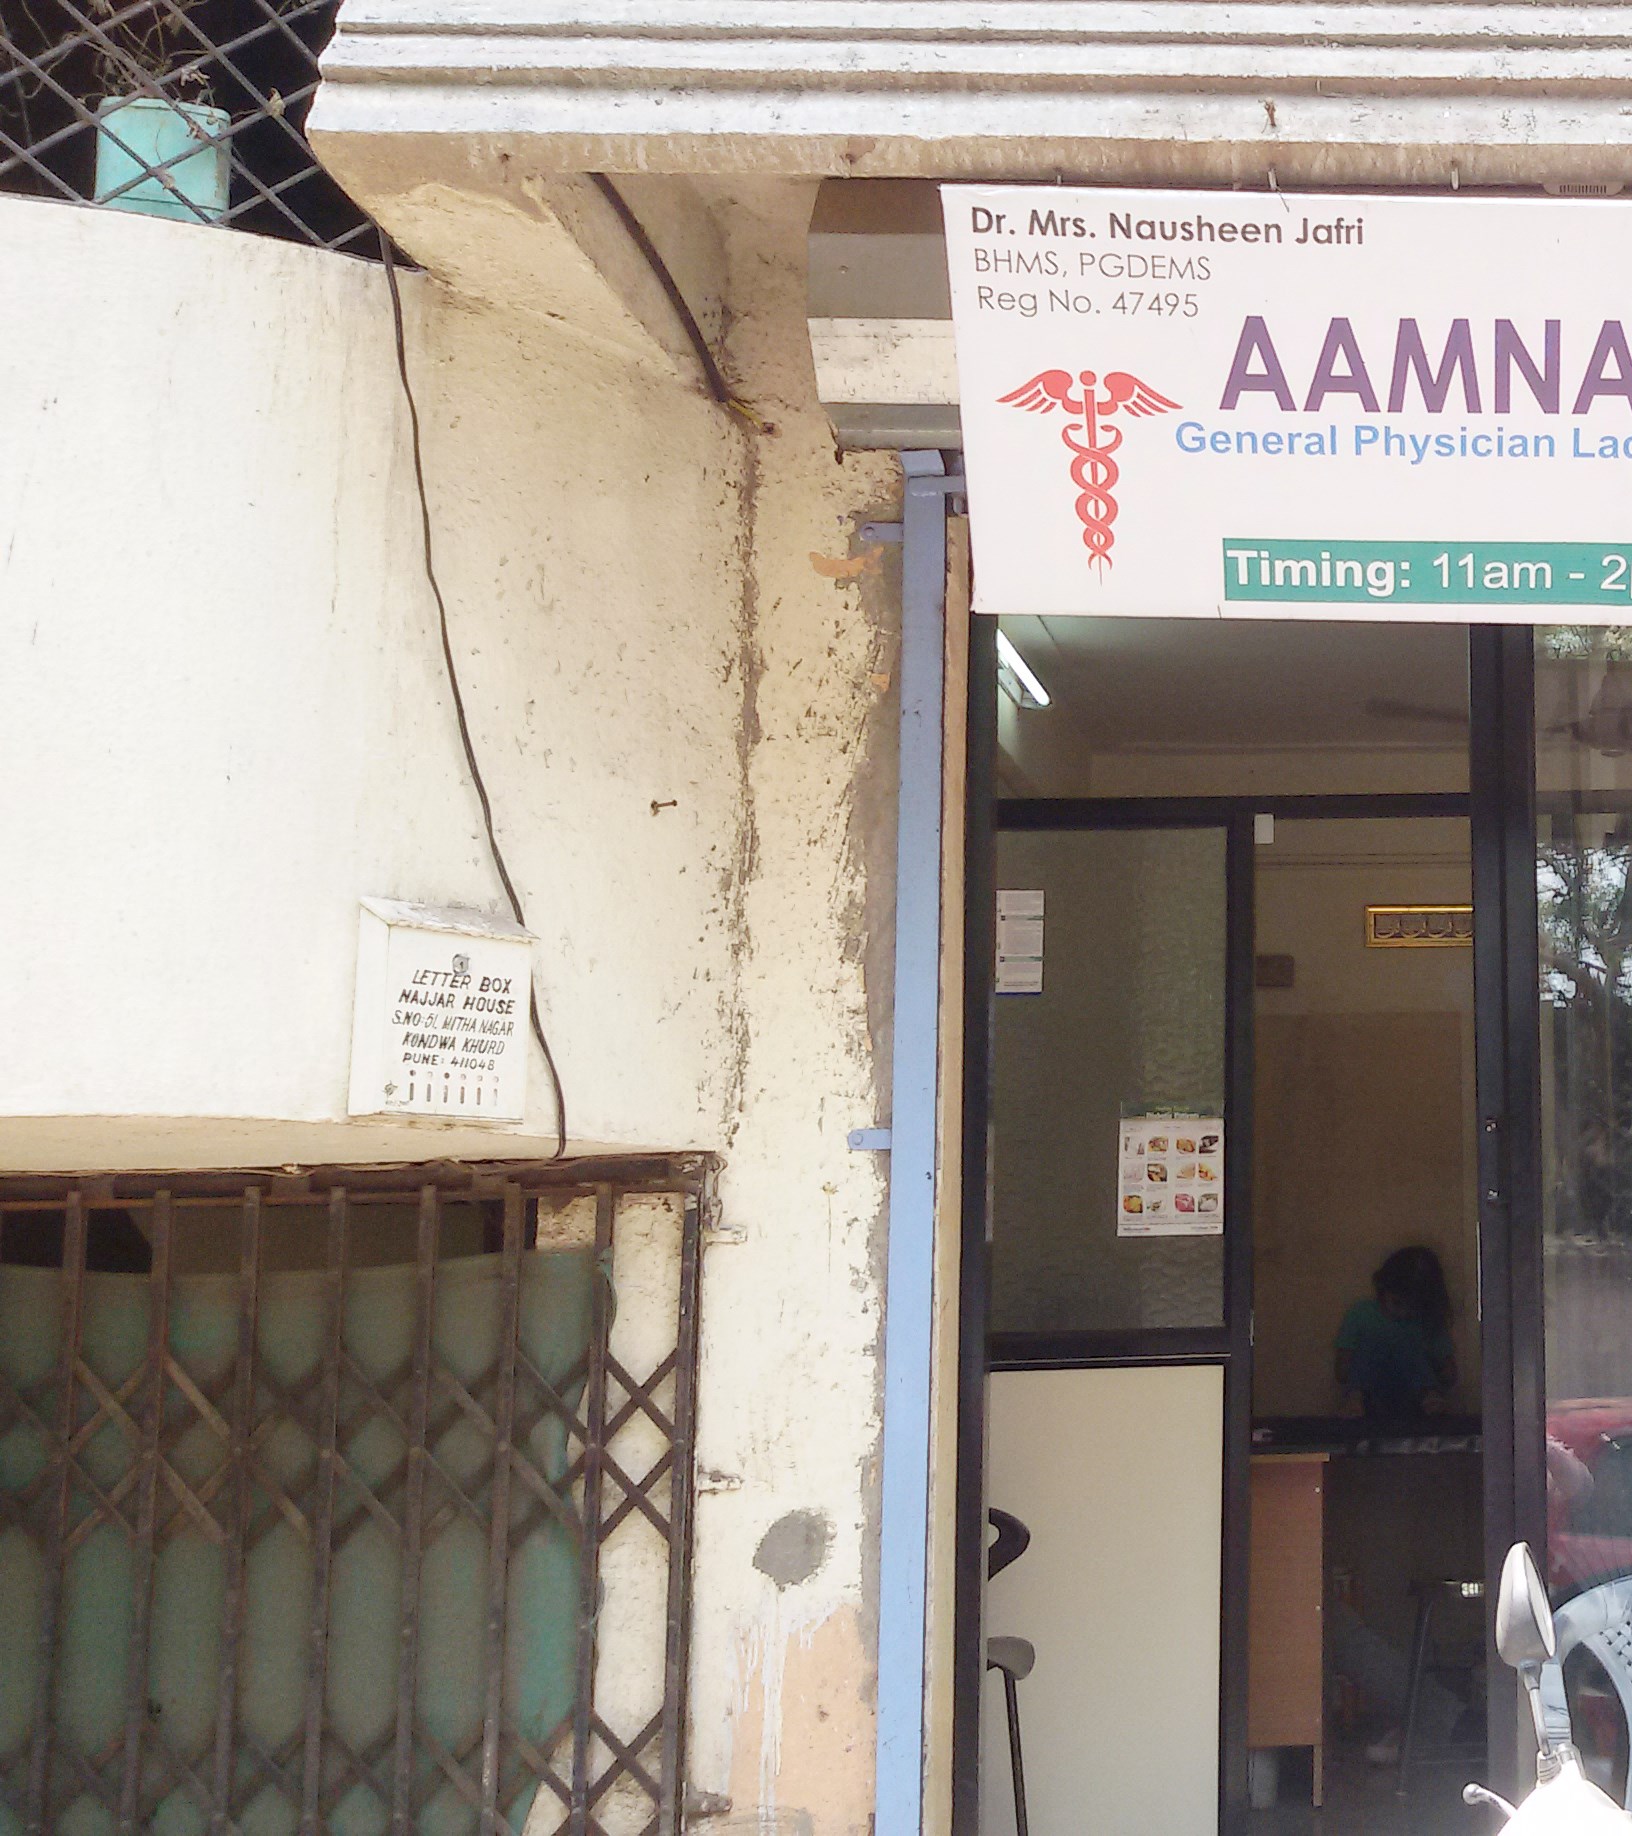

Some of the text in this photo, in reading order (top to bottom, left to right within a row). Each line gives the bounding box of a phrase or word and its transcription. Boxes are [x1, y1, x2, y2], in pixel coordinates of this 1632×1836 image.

[971, 207, 1364, 246] Dr. Mrs. Nausheen Jafri
[974, 249, 1211, 281] BHMS, PGDEMS
[977, 285, 1198, 318] Reg No. 47495
[1175, 422, 1337, 456] General
[1353, 424, 1556, 465] Physician
[1226, 549, 1411, 596] Timing:
[1432, 553, 1552, 590] 11am
[412, 970, 512, 993] LETTER BOX
[399, 989, 515, 1014] NAJJAR HOUSE
[480, 1020, 514, 1036] NAGAR
[402, 1032, 505, 1055] KONDWA KHURD
[450, 1056, 495, 1071] 411048
